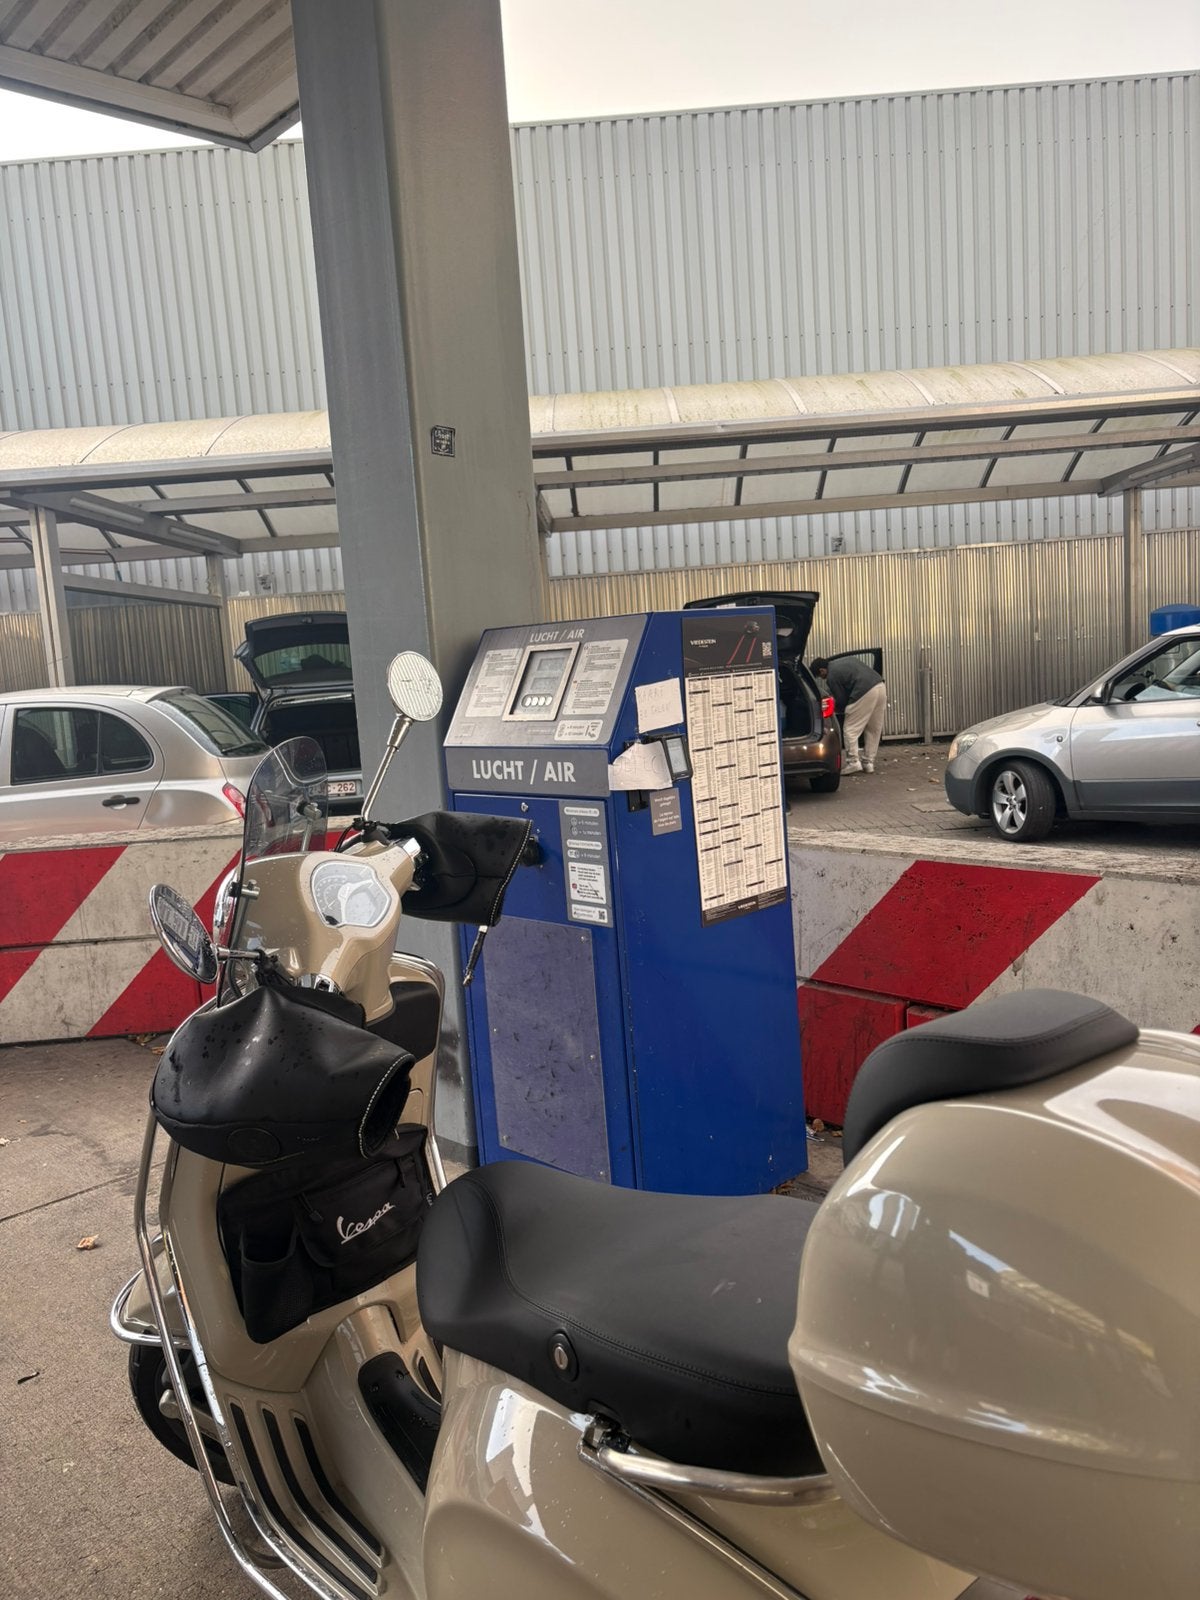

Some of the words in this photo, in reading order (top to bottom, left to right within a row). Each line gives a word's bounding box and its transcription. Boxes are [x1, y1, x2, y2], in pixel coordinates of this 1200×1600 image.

[529, 631, 559, 643] LUCHT
[567, 628, 586, 640] AIR
[472, 759, 524, 781] LUCHT
[530, 759, 538, 785] /
[544, 761, 577, 783] AIR
[336, 1201, 396, 1245] Vespa
